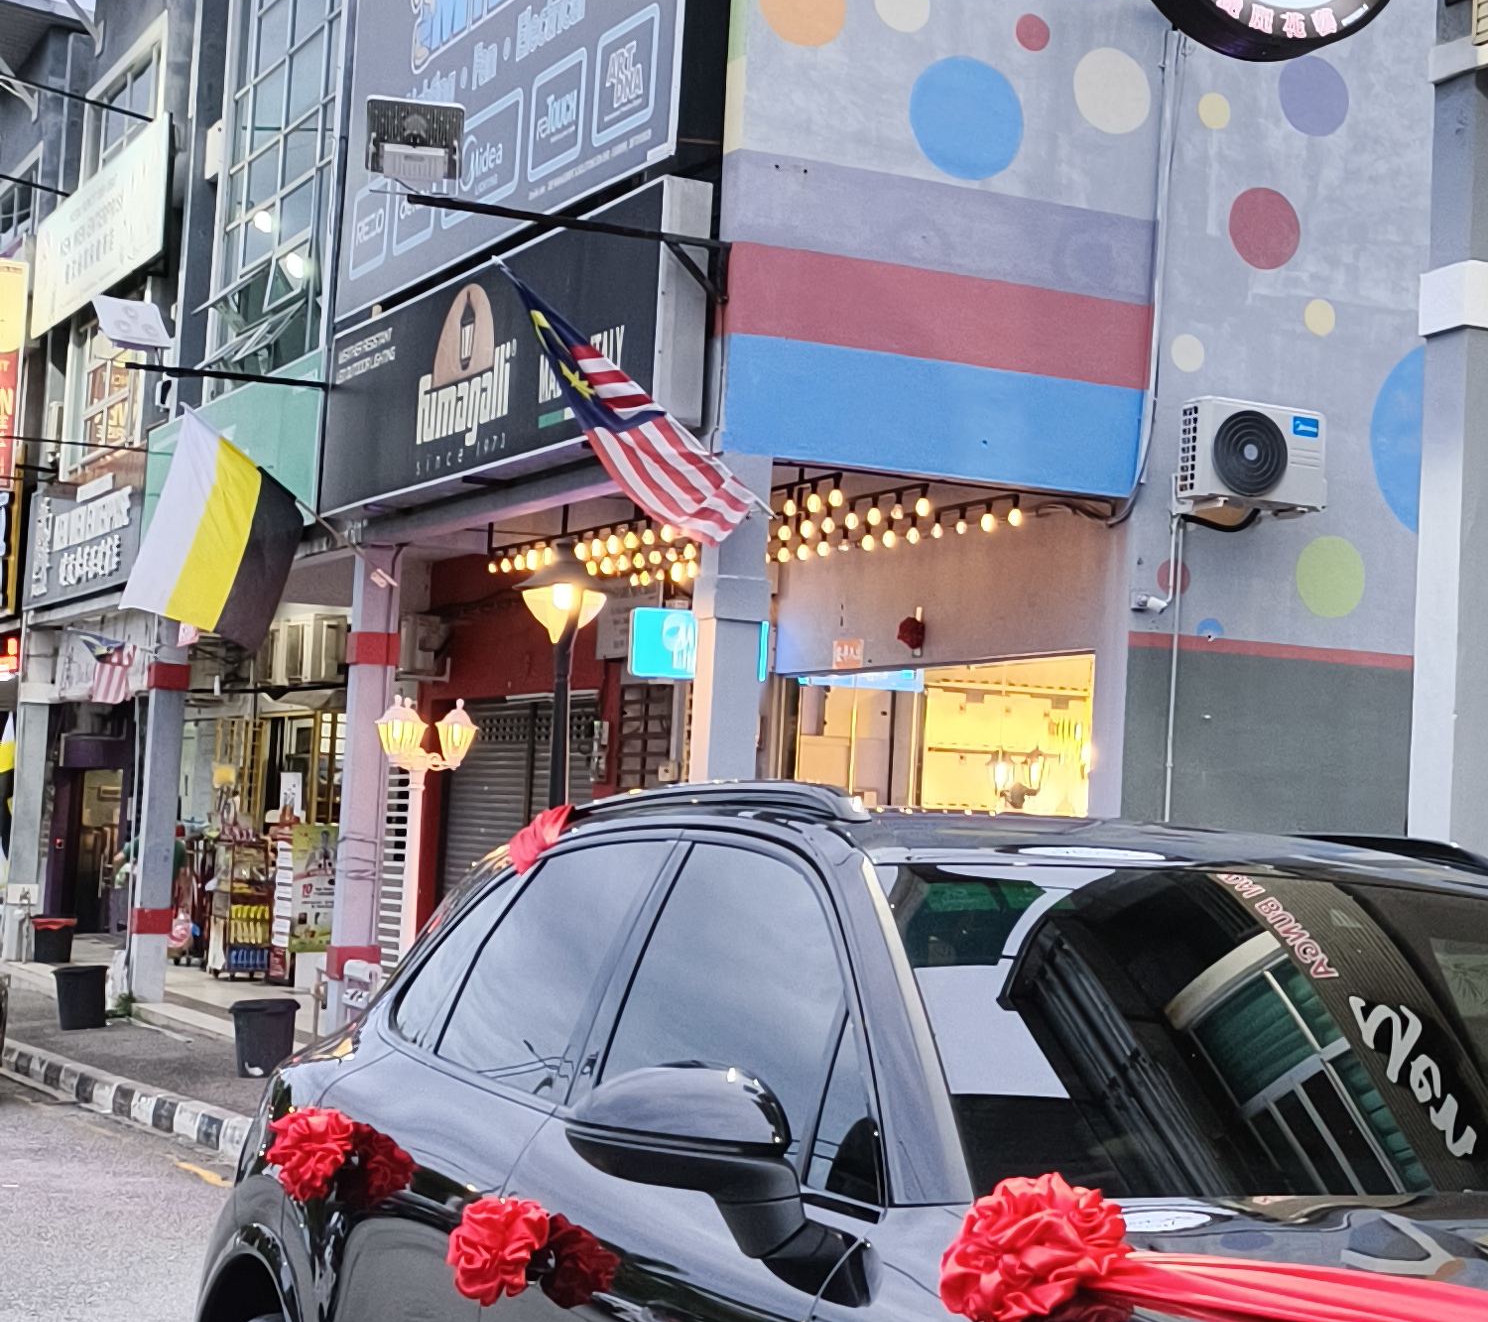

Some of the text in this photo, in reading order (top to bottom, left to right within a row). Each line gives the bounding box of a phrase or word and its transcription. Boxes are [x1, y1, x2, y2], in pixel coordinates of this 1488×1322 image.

[472, 41, 498, 91] Fan
[606, 40, 637, 88] ART
[613, 63, 644, 109] DNA
[460, 134, 503, 192] Midea
[415, 340, 512, 447] fumagalli
[415, 447, 465, 476] since
